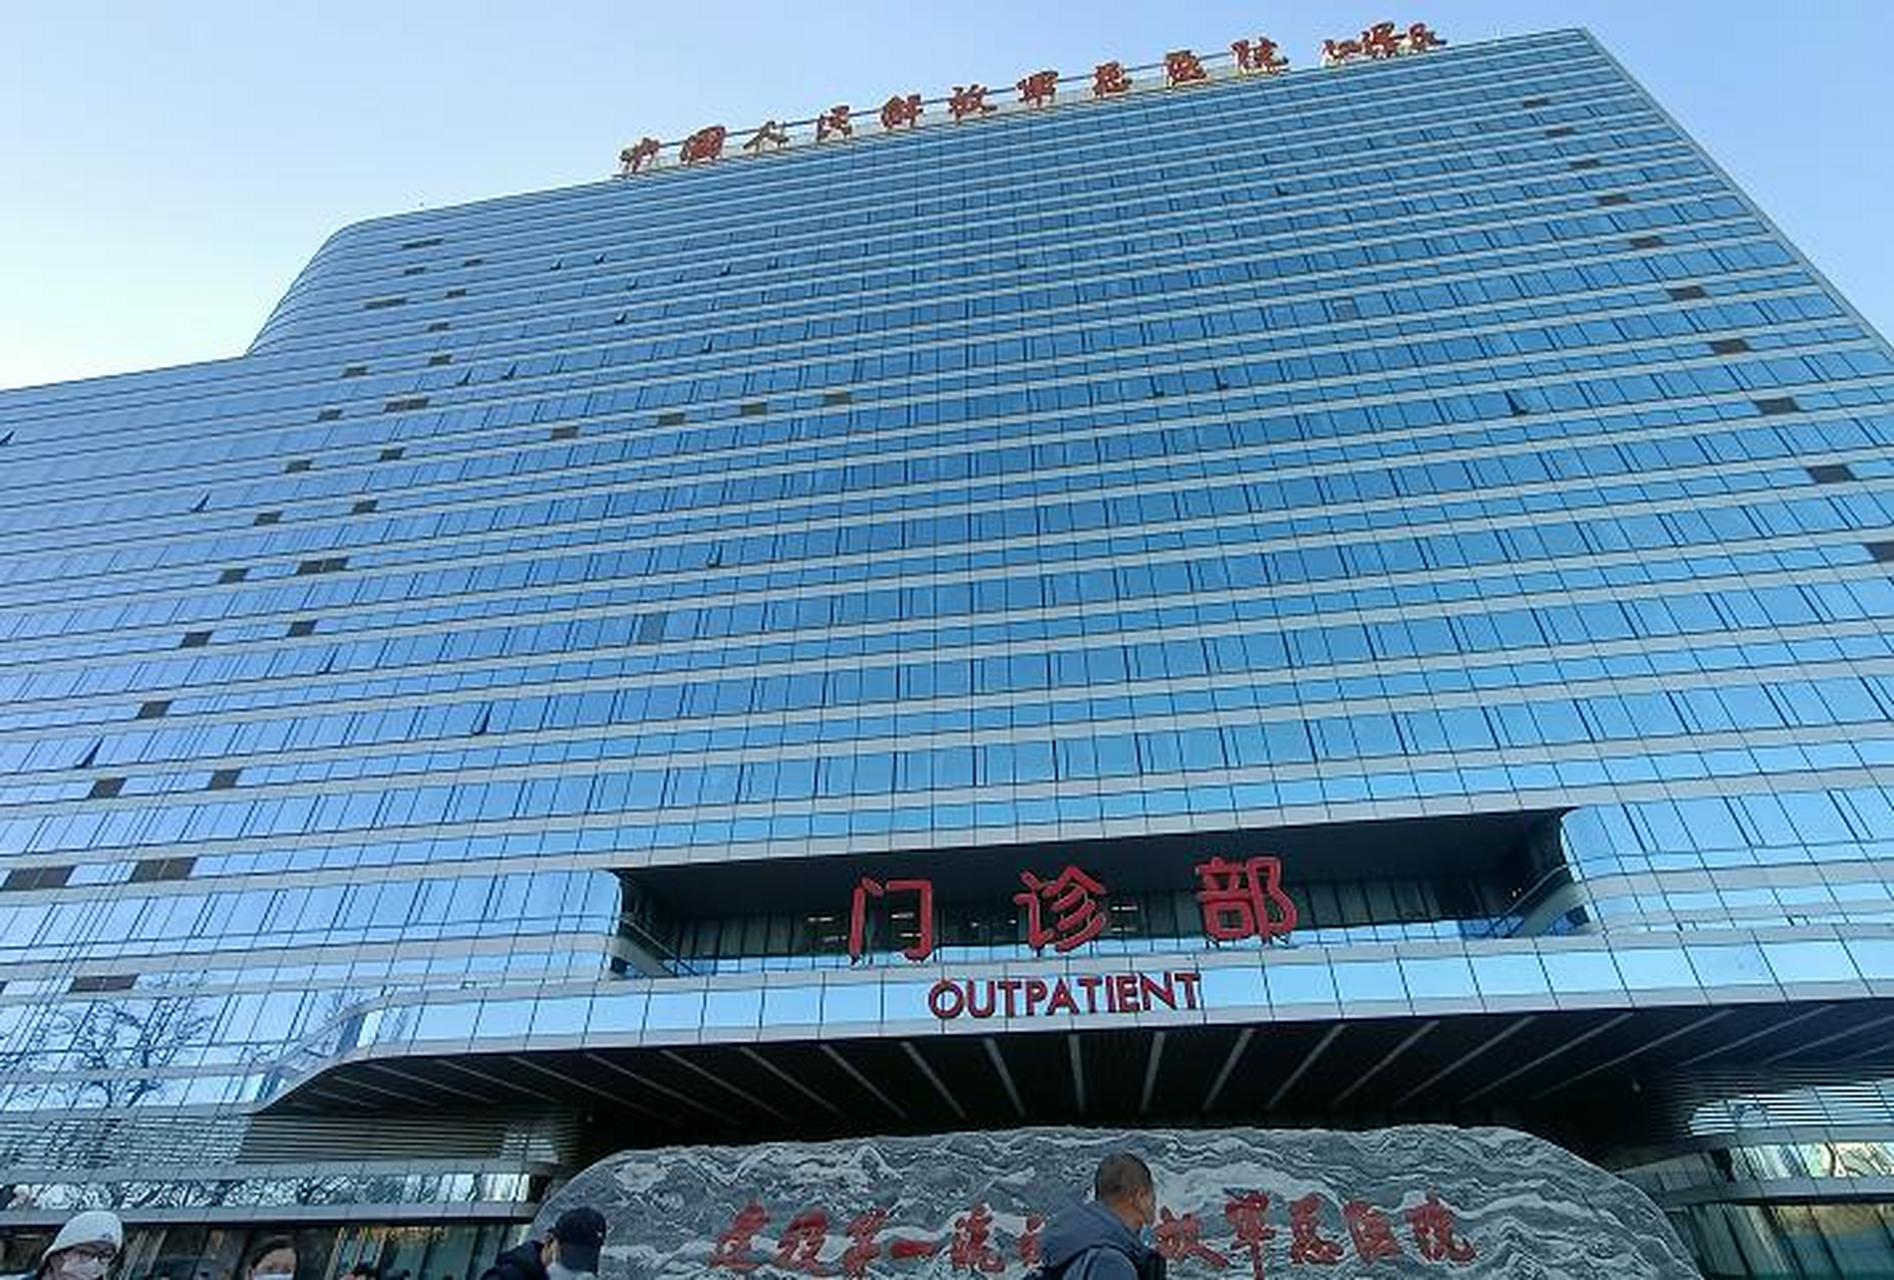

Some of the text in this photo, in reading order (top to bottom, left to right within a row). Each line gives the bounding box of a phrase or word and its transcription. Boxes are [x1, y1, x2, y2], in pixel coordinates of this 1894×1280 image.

[849, 856, 1298, 964] 门诊部
[928, 972, 1201, 1020] OUTPATIENT
